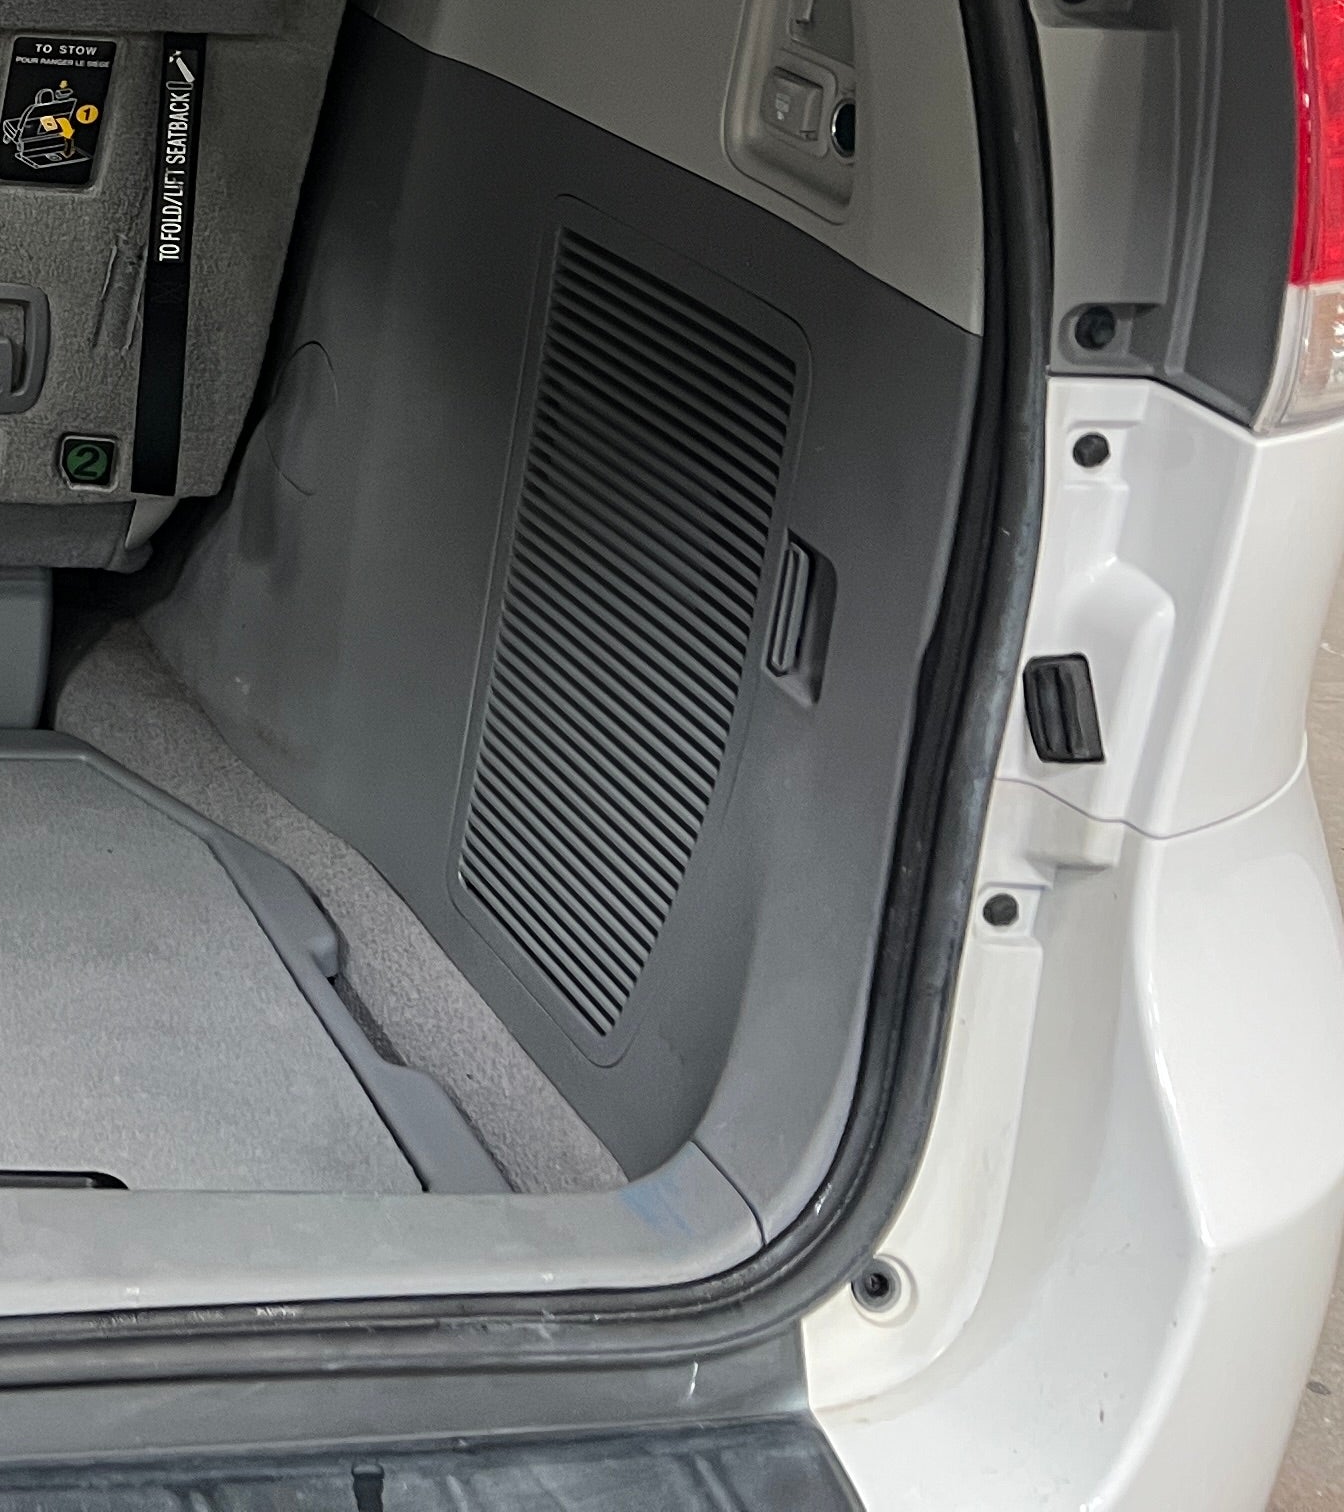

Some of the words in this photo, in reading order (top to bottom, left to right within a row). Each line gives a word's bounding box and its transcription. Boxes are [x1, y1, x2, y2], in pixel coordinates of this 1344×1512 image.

[15, 56, 39, 64] POUR
[40, 58, 74, 66] RANGER
[75, 59, 85, 67] LE
[35, 44, 53, 54] TO
[59, 45, 97, 56] STOW
[165, 92, 191, 164] SEATBACK
[160, 167, 185, 241] FOLD/LIFT
[159, 243, 180, 262] TO
[73, 446, 101, 477] 2
